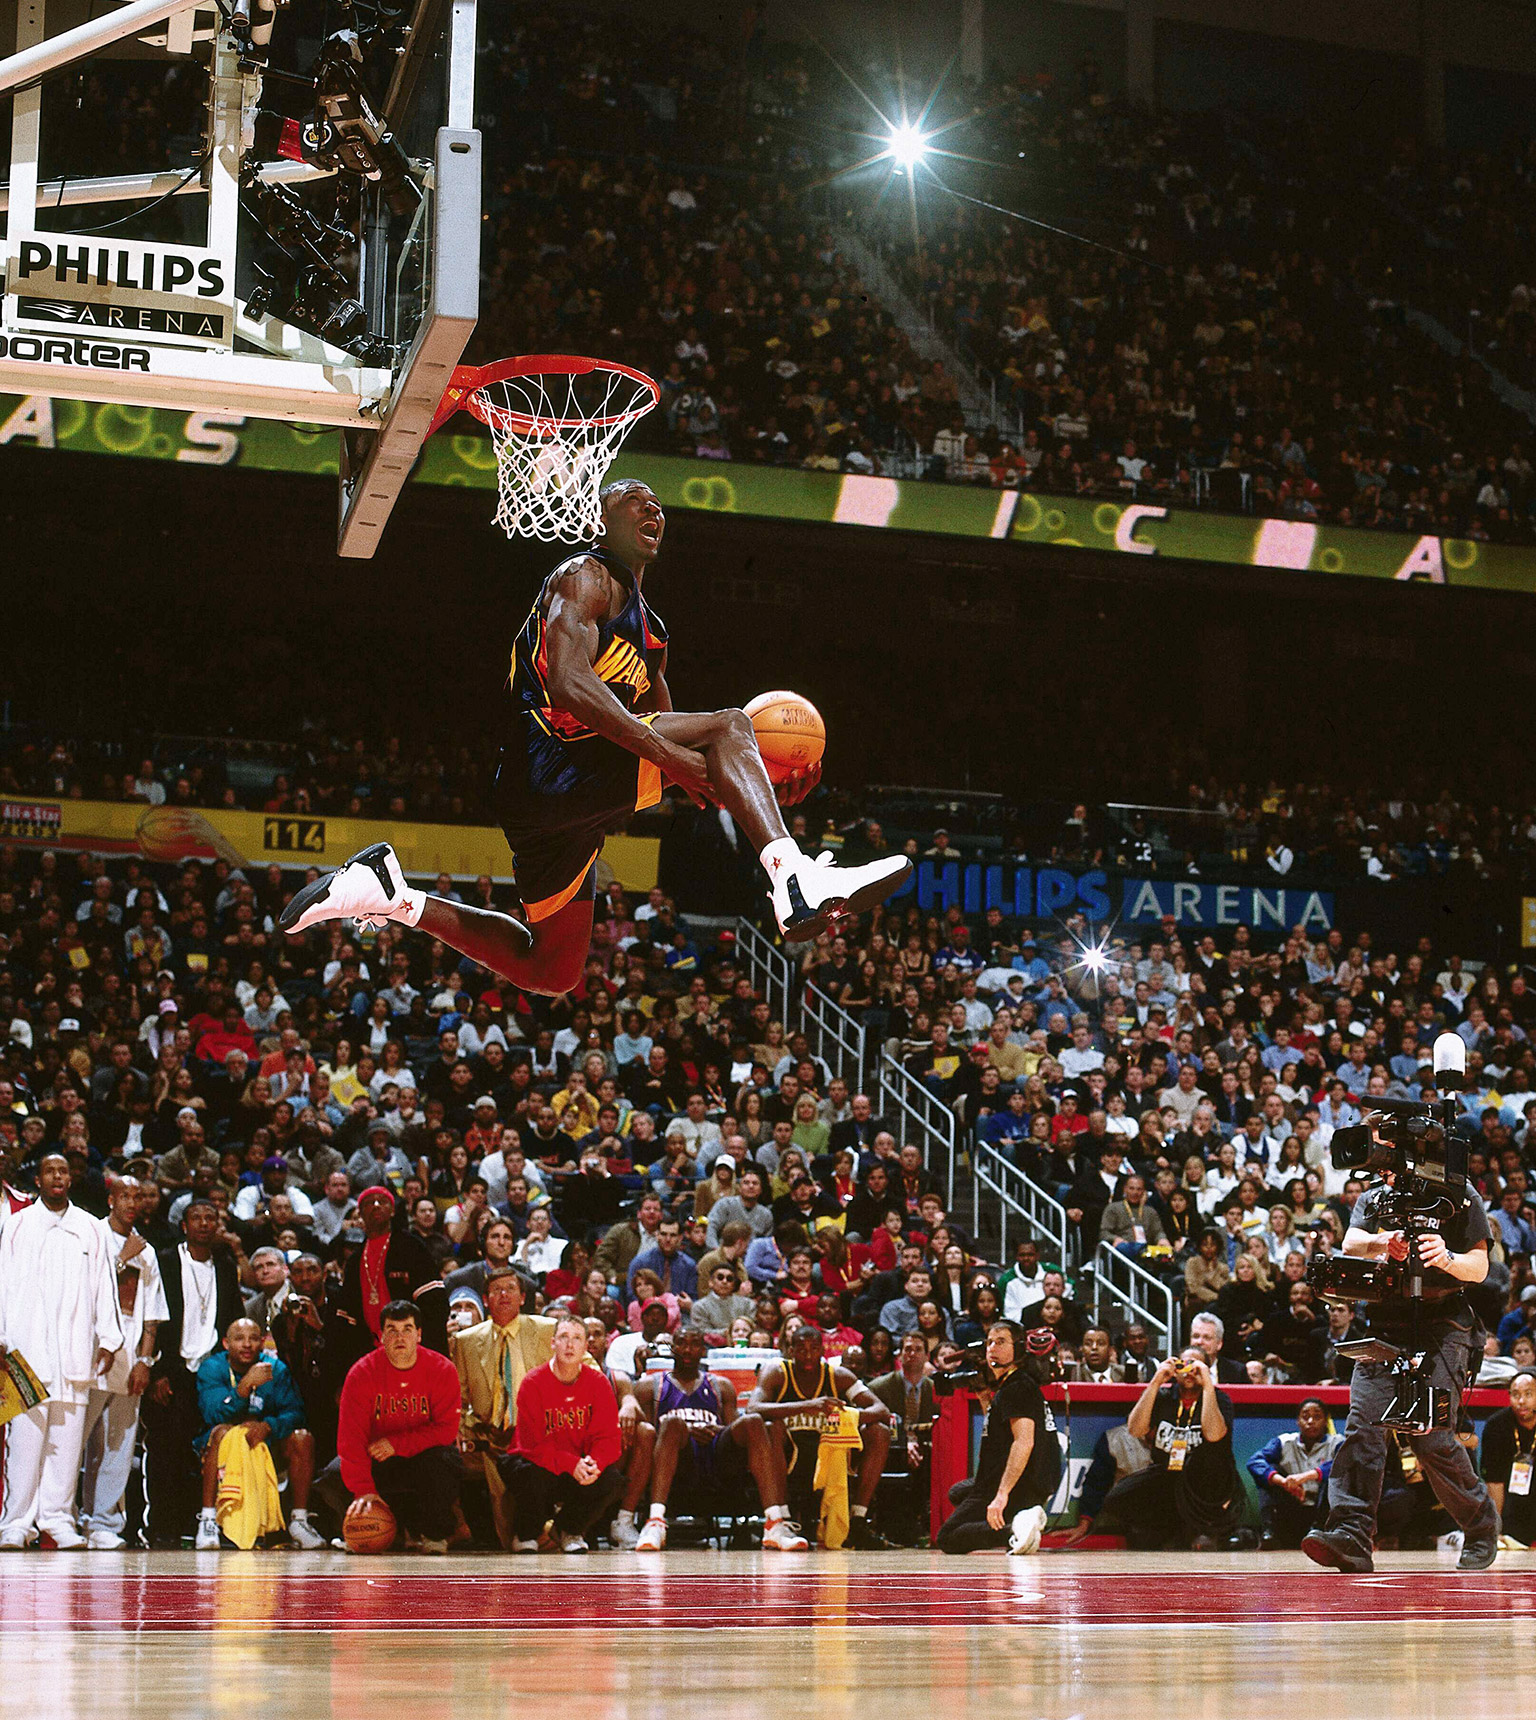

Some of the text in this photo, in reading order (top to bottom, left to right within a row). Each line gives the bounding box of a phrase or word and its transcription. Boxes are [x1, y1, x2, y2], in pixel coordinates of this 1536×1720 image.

[18, 241, 225, 297] PHILIPS
[77, 305, 216, 337] ARENA
[266, 822, 323, 851] 114
[1130, 879, 1332, 930] ARENA
